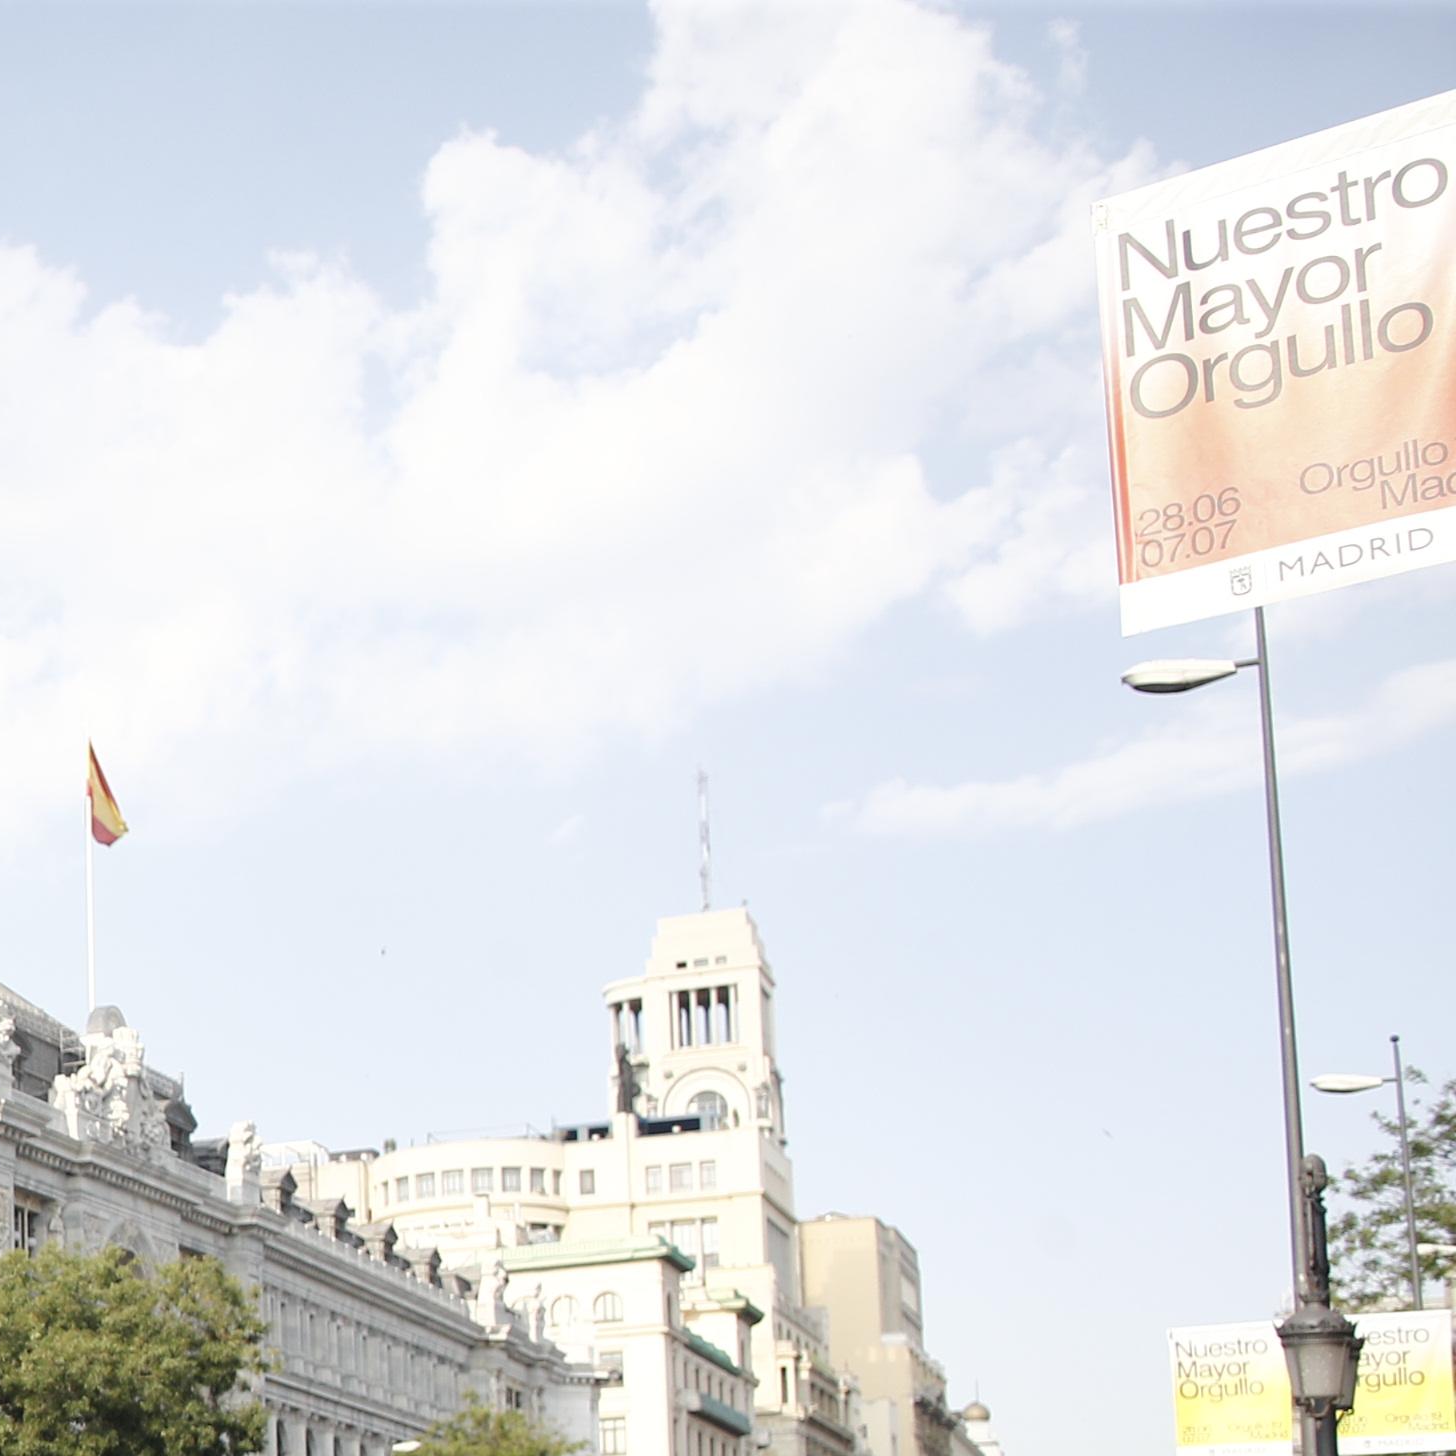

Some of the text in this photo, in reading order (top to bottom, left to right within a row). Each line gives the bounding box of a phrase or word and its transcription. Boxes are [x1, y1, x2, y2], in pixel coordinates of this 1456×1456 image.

[1117, 157, 1449, 292] Nuestro
[1122, 241, 1383, 358] Mayor
[1129, 298, 1434, 420] Orgullo
[1299, 439, 1449, 496] Orgullo
[1138, 486, 1242, 539] 28.06
[1140, 519, 1238, 569] 07.07
[1278, 527, 1435, 582] MADRID
[1175, 1339, 1269, 1359] Nuestro
[1358, 1350, 1411, 1371] ayor
[1364, 1326, 1430, 1346] estro
[1177, 1360, 1250, 1382] Mayor
[1179, 1378, 1265, 1403] Orgullo
[1356, 1367, 1426, 1393] rgullo
